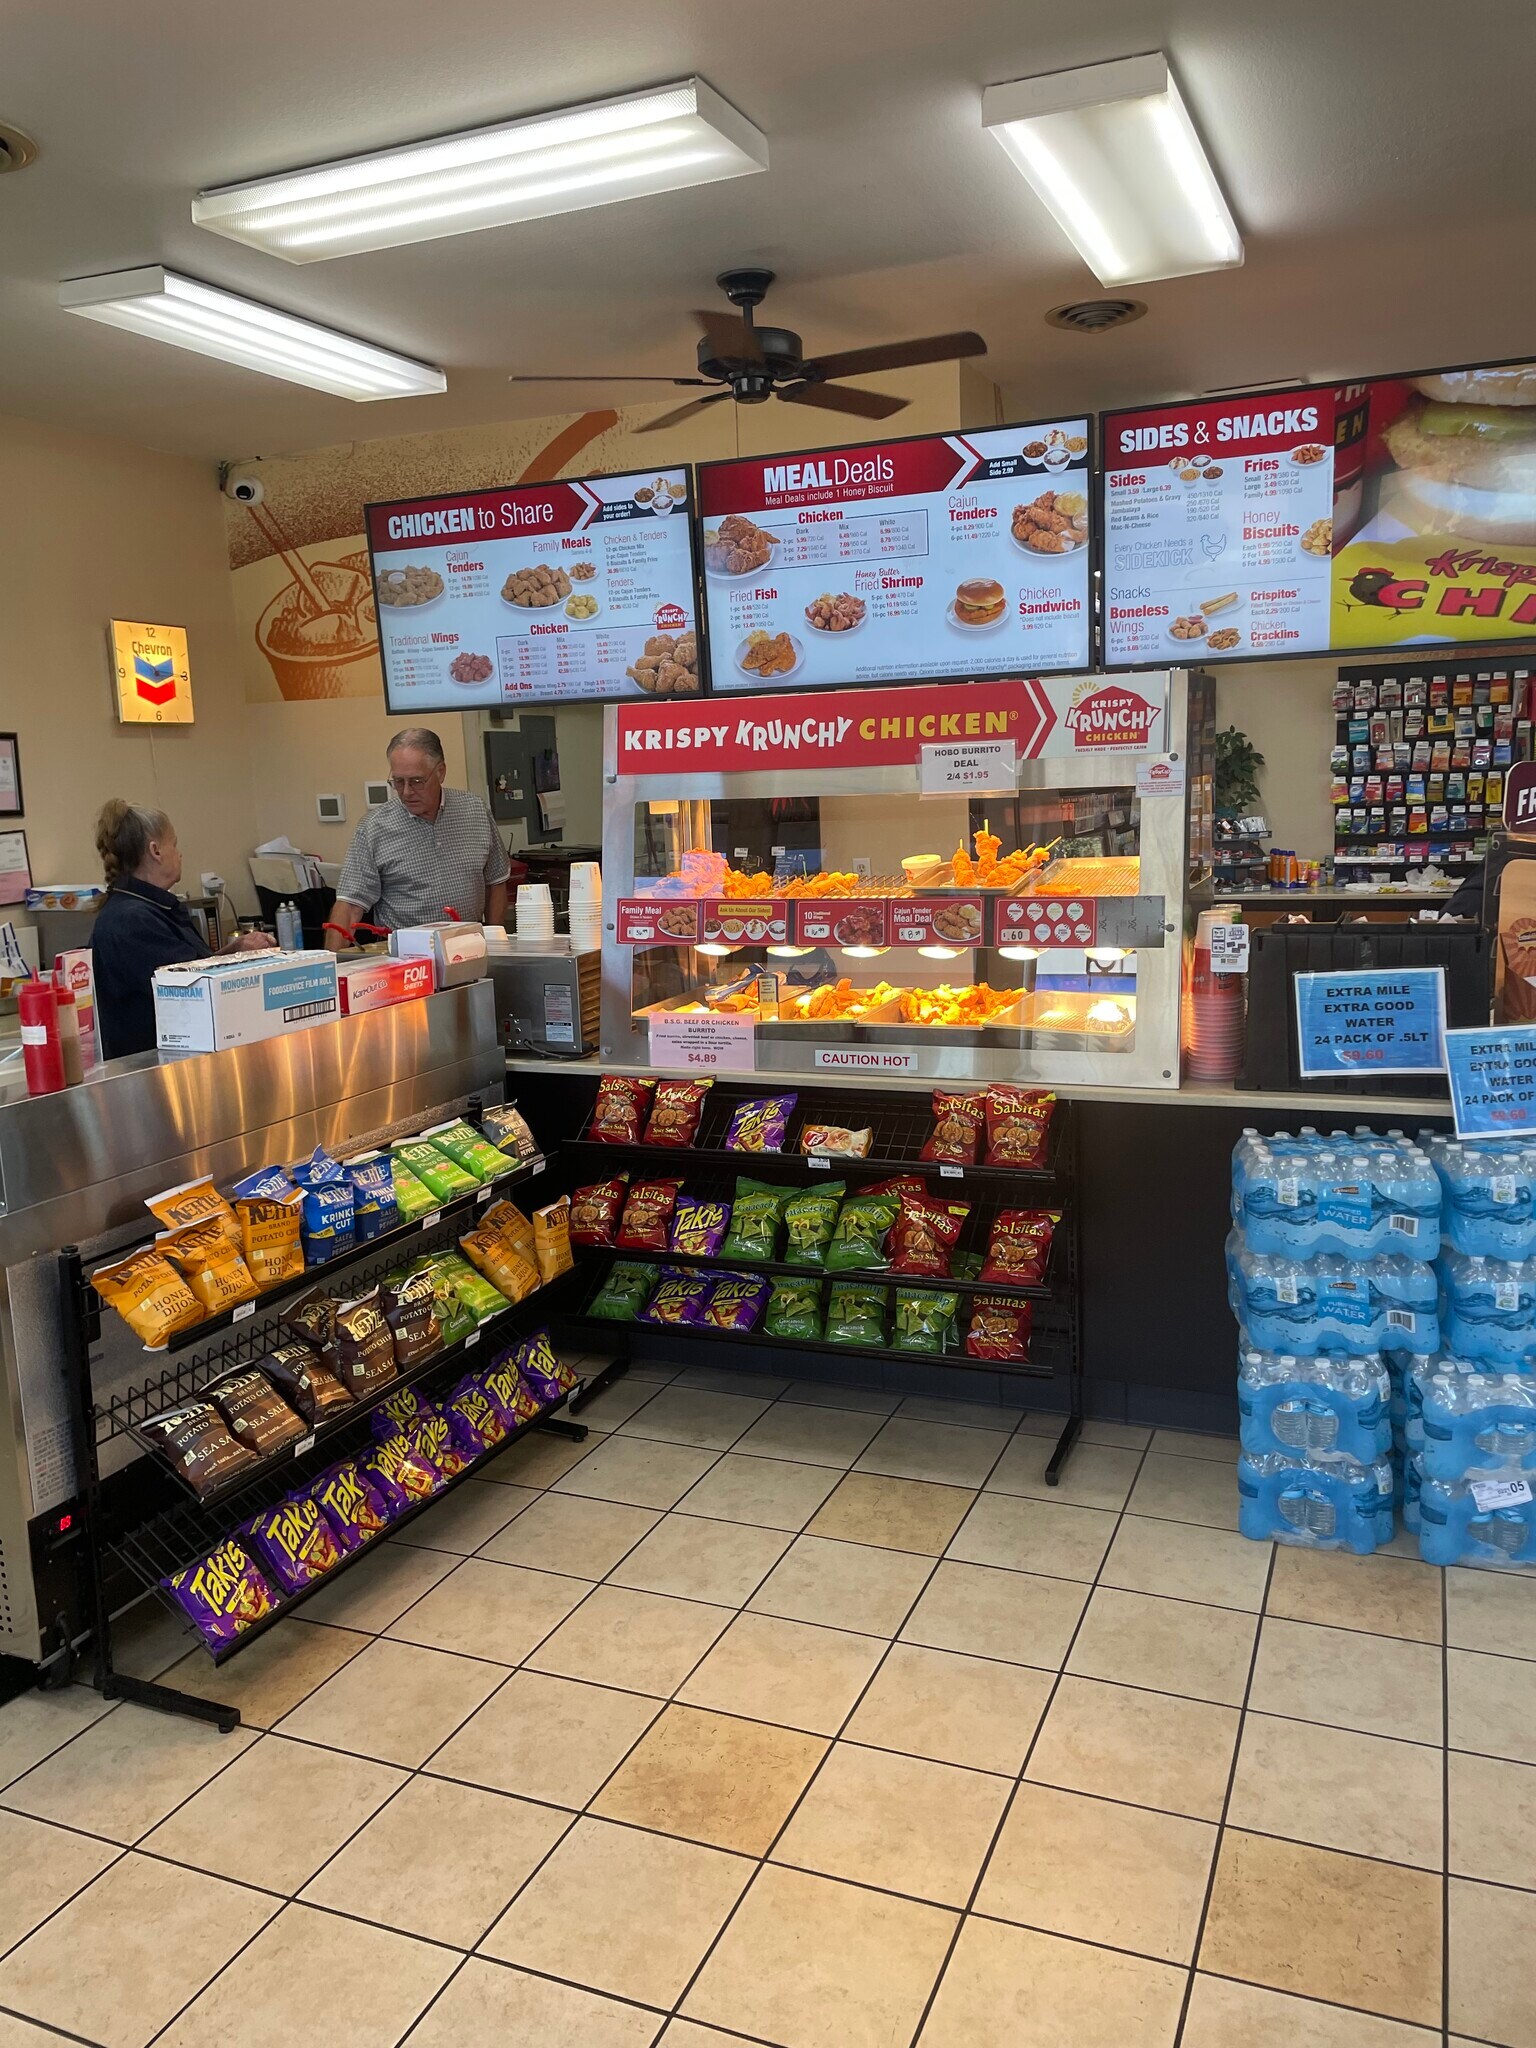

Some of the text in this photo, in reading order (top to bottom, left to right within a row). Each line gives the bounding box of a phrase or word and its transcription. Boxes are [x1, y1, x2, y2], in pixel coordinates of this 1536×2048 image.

[1120, 407, 1318, 453] SIDES & SNACKS
[1002, 459, 1017, 467] Small
[1245, 459, 1279, 473] Fries
[764, 454, 894, 493] MEAL Deals
[1110, 474, 1146, 487] Sides
[765, 497, 782, 505] Meal
[785, 495, 805, 503] Deals
[807, 491, 833, 500] include
[843, 487, 866, 497] Honey
[868, 483, 894, 494] Biscuit
[948, 495, 978, 510] Cajun
[388, 502, 553, 539] CHICKEN to Share
[615, 511, 631, 519] order!
[799, 511, 843, 524] Chicken
[949, 507, 997, 521] Tenders
[1243, 511, 1280, 524] Honey
[1111, 522, 1151, 530] Mac-N-Cheese
[1243, 524, 1299, 540] Biscuits
[533, 540, 559, 553] Family
[562, 537, 591, 549] Meals
[604, 536, 631, 545] Chicken
[639, 531, 667, 540] Tenders
[1115, 543, 1133, 553] Every
[1135, 541, 1162, 551] Chicken
[1164, 539, 1185, 548] Needs
[446, 550, 468, 563] Cajun
[1115, 548, 1193, 571] SIDEKICK
[447, 561, 484, 573] Tenders
[855, 568, 900, 579] Honey Butter
[607, 578, 633, 587] Tenders
[855, 575, 923, 591] Fried Shrimp
[730, 588, 778, 602] Fried Fish
[1019, 587, 1061, 600] Chicken
[1110, 587, 1150, 600] Snacks
[1019, 599, 1081, 615] Sandwich
[1110, 605, 1169, 619] Boneless
[146, 627, 156, 637] 12
[531, 624, 568, 635] Chicken
[1110, 621, 1144, 634] Wings
[1251, 621, 1286, 630] Chicken
[390, 633, 459, 647] Traditional Wings
[1251, 630, 1299, 641] Cracklins
[132, 641, 172, 656] Chevron
[119, 668, 125, 678] 9
[505, 683, 518, 691] Add
[1092, 699, 1133, 708] KRISPY
[156, 711, 162, 721] 6
[1065, 707, 1161, 732] KRUNCHY
[624, 726, 730, 750] KRISPY
[735, 716, 853, 751] KRUNCHY
[1086, 732, 1138, 741] CHICKEN
[934, 746, 1001, 757] HOBO BURRITO
[954, 760, 979, 768] DEAL
[947, 771, 989, 781] 2/4 $1.95
[622, 906, 661, 915] Family Meal
[804, 912, 812, 920] 10
[894, 914, 932, 923] Meal Deal
[404, 966, 428, 984] FOIL
[221, 975, 260, 992] MONOGRAM
[269, 977, 332, 996] FOODSERVICE FILM ROLL
[404, 981, 423, 991] SHEETS
[157, 987, 203, 999] MONOGRAM
[1327, 986, 1410, 997] EXTRA MILE
[1325, 1001, 1414, 1013] EXTRA GOOD
[1346, 1018, 1394, 1028] WATER
[1315, 1033, 1429, 1045] 24 PACK OF .5LT
[1470, 1044, 1512, 1055] EXTRA
[688, 1054, 716, 1063] $4.89
[822, 1053, 910, 1067] CAUTION HOT
[1490, 1075, 1533, 1087] WATER
[599, 1080, 638, 1102] Salsitas
[1465, 1092, 1534, 1105] 24 PACK OF
[937, 1099, 985, 1120] Salsitas
[993, 1102, 1048, 1119] Salsitas
[734, 1103, 779, 1137] Takis
[674, 1206, 723, 1238] Takis
[903, 1206, 952, 1234] Salsitas
[1322, 1210, 1367, 1224] WATER
[335, 1219, 350, 1230] CUT
[993, 1219, 1044, 1237] Salsitas
[215, 1267, 244, 1288] HONEY
[221, 1278, 247, 1296] DIJON
[654, 1279, 706, 1302] Takis
[709, 1280, 762, 1303] Takis
[153, 1288, 192, 1311] HONEY
[973, 1295, 1027, 1309] Salsitas
[163, 1297, 197, 1317] DIJON
[1322, 1306, 1366, 1320] WATER
[485, 1358, 519, 1409] Takis
[249, 1402, 287, 1429] SEA SALT
[177, 1422, 209, 1448] POTATO
[366, 1435, 411, 1487] Takis
[1510, 1481, 1524, 1493] 05
[267, 1498, 318, 1562] Takis
[190, 1541, 245, 1617] Takis
